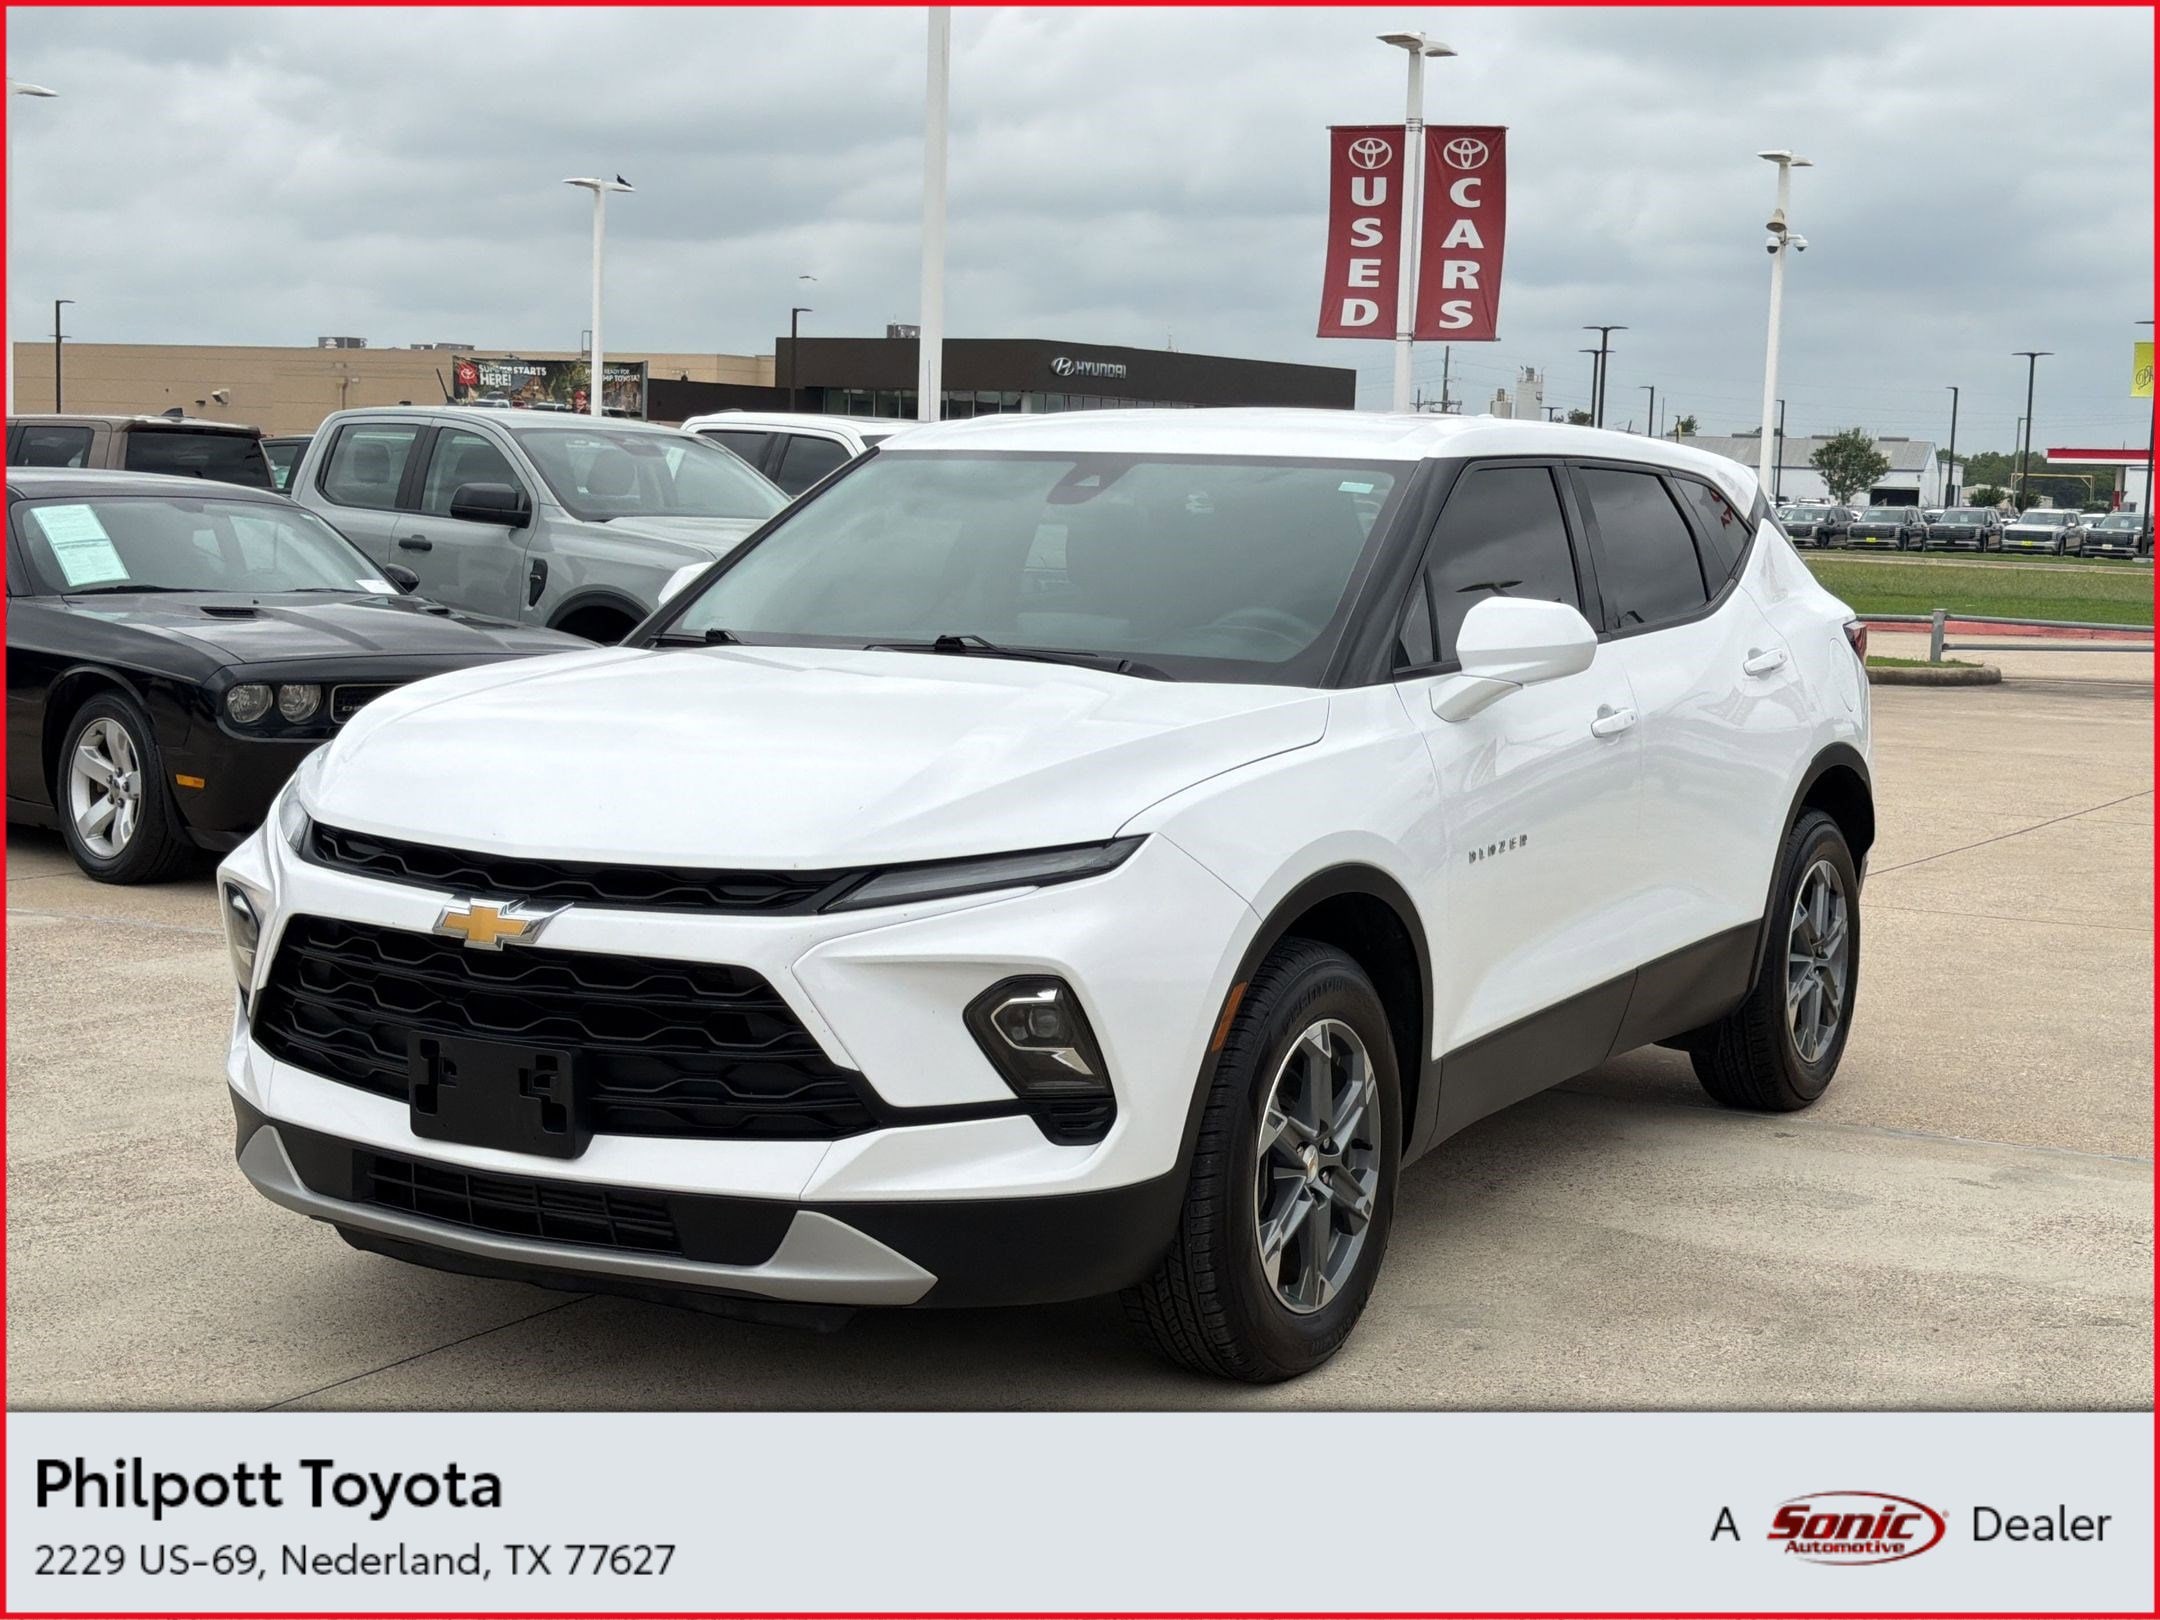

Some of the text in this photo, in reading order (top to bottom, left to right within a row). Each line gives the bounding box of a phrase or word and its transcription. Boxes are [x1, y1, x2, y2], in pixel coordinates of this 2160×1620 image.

[1340, 176, 1387, 327] USED
[1439, 177, 1485, 329] CARS
[479, 373, 512, 387] HERE!
[513, 366, 547, 376] STARTS
[1075, 360, 1127, 379] HYUNDAI
[1468, 833, 1528, 865] BLAZER
